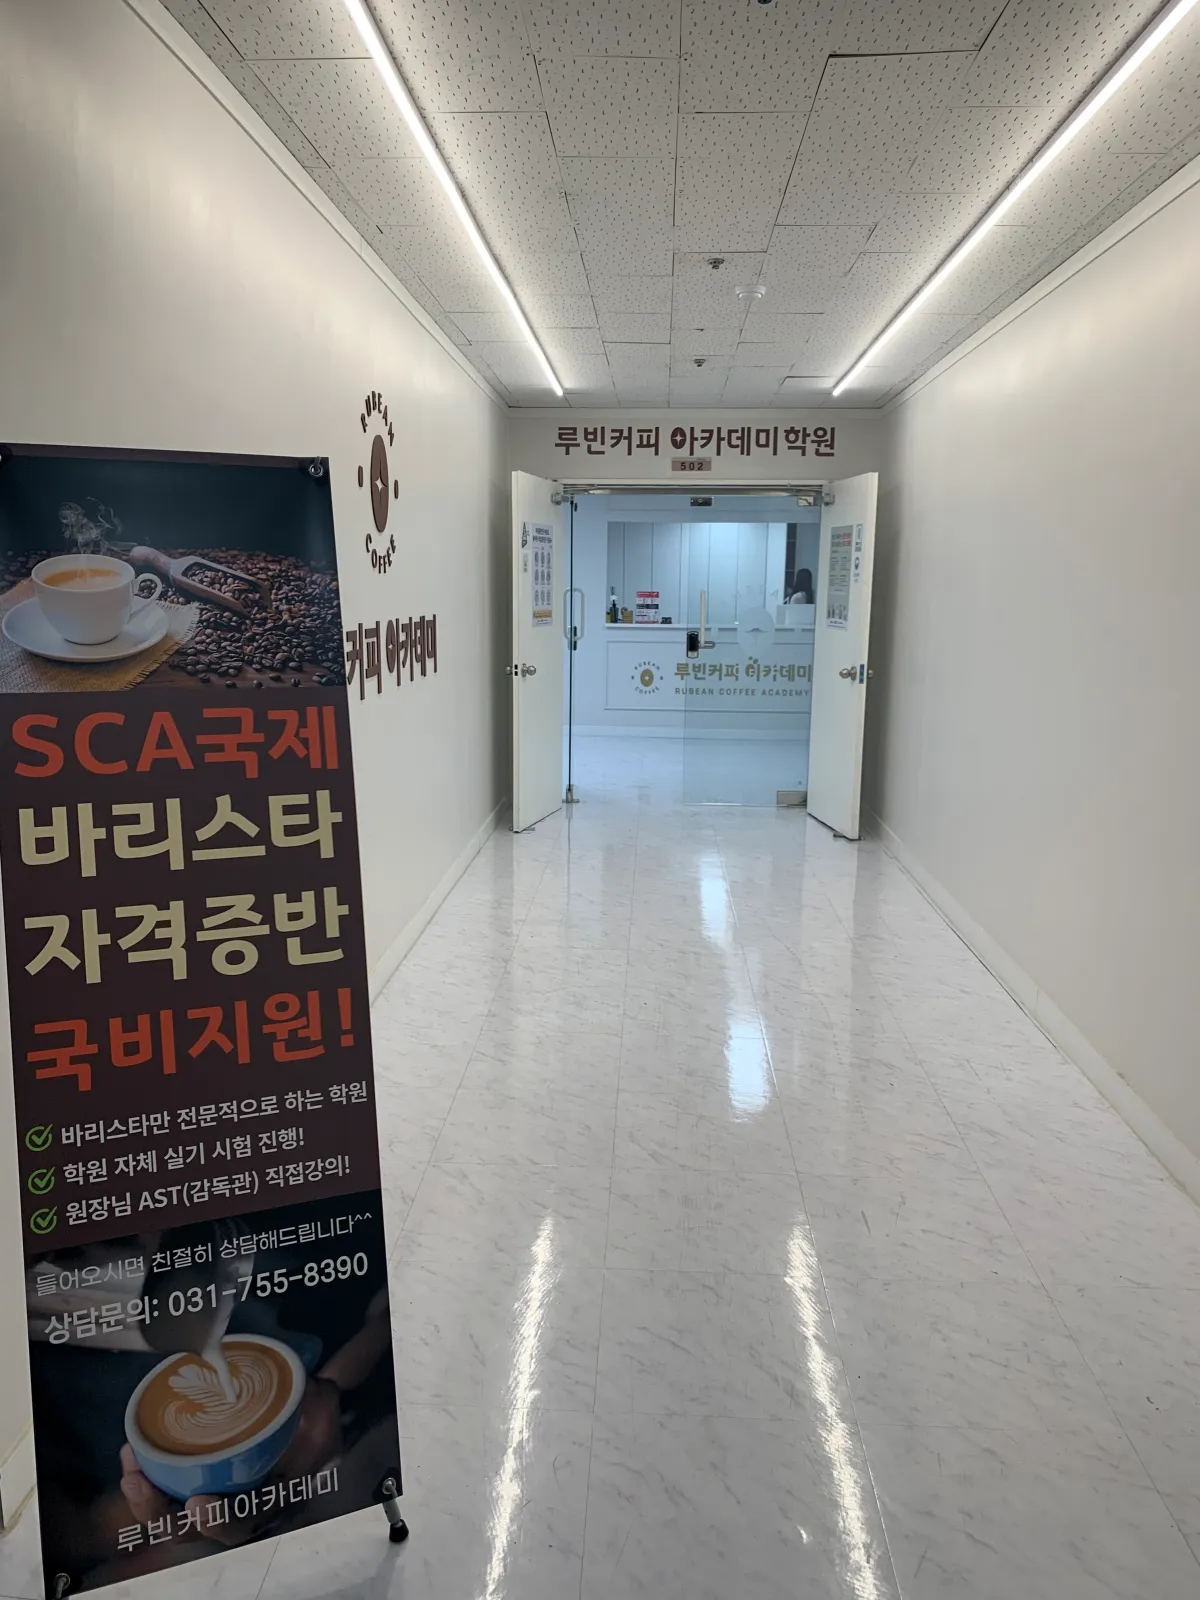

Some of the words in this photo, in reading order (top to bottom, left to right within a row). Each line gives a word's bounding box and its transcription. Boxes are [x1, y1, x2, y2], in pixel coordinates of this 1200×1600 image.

[360, 390, 395, 447] RUBEAN
[554, 426, 660, 456] 루빈커피
[670, 426, 836, 457] 아카데미학원
[680, 461, 704, 471] 502
[366, 533, 397, 574] COFFEE
[346, 620, 382, 701] 커피
[385, 614, 437, 687] 아카데미
[674, 663, 740, 682] 루빈커피
[674, 688, 714, 696] RUBEAN
[719, 688, 757, 697] COFFEE
[761, 688, 810, 698] ACADEMY
[12, 705, 339, 779] SCA국제
[18, 790, 343, 877] 바리스타
[24, 886, 349, 984] 자격증반
[27, 987, 355, 1092] 국비지원!
[61, 1109, 171, 1148] 바리스타만
[177, 1095, 280, 1133] 전문적으로
[284, 1089, 324, 1113] 하는
[328, 1080, 368, 1107] 학원
[63, 1158, 108, 1187] 학원
[114, 1150, 159, 1178] 자체
[164, 1142, 206, 1171] 실기
[211, 1135, 252, 1162] 시험
[258, 1126, 305, 1154] 진행!
[65, 1192, 132, 1227] 원장님
[138, 1170, 260, 1212] AST(감독관)
[265, 1155, 351, 1188] 직접강의!
[35, 1256, 145, 1297] 들어오시면
[151, 1242, 213, 1274] 친절히
[219, 1212, 373, 1260] 상담해드립니다^^
[44, 1296, 160, 1346] 상담문의:
[168, 1252, 369, 1317] 031-755-8390
[117, 1466, 339, 1553] 루빈커피아카데미
